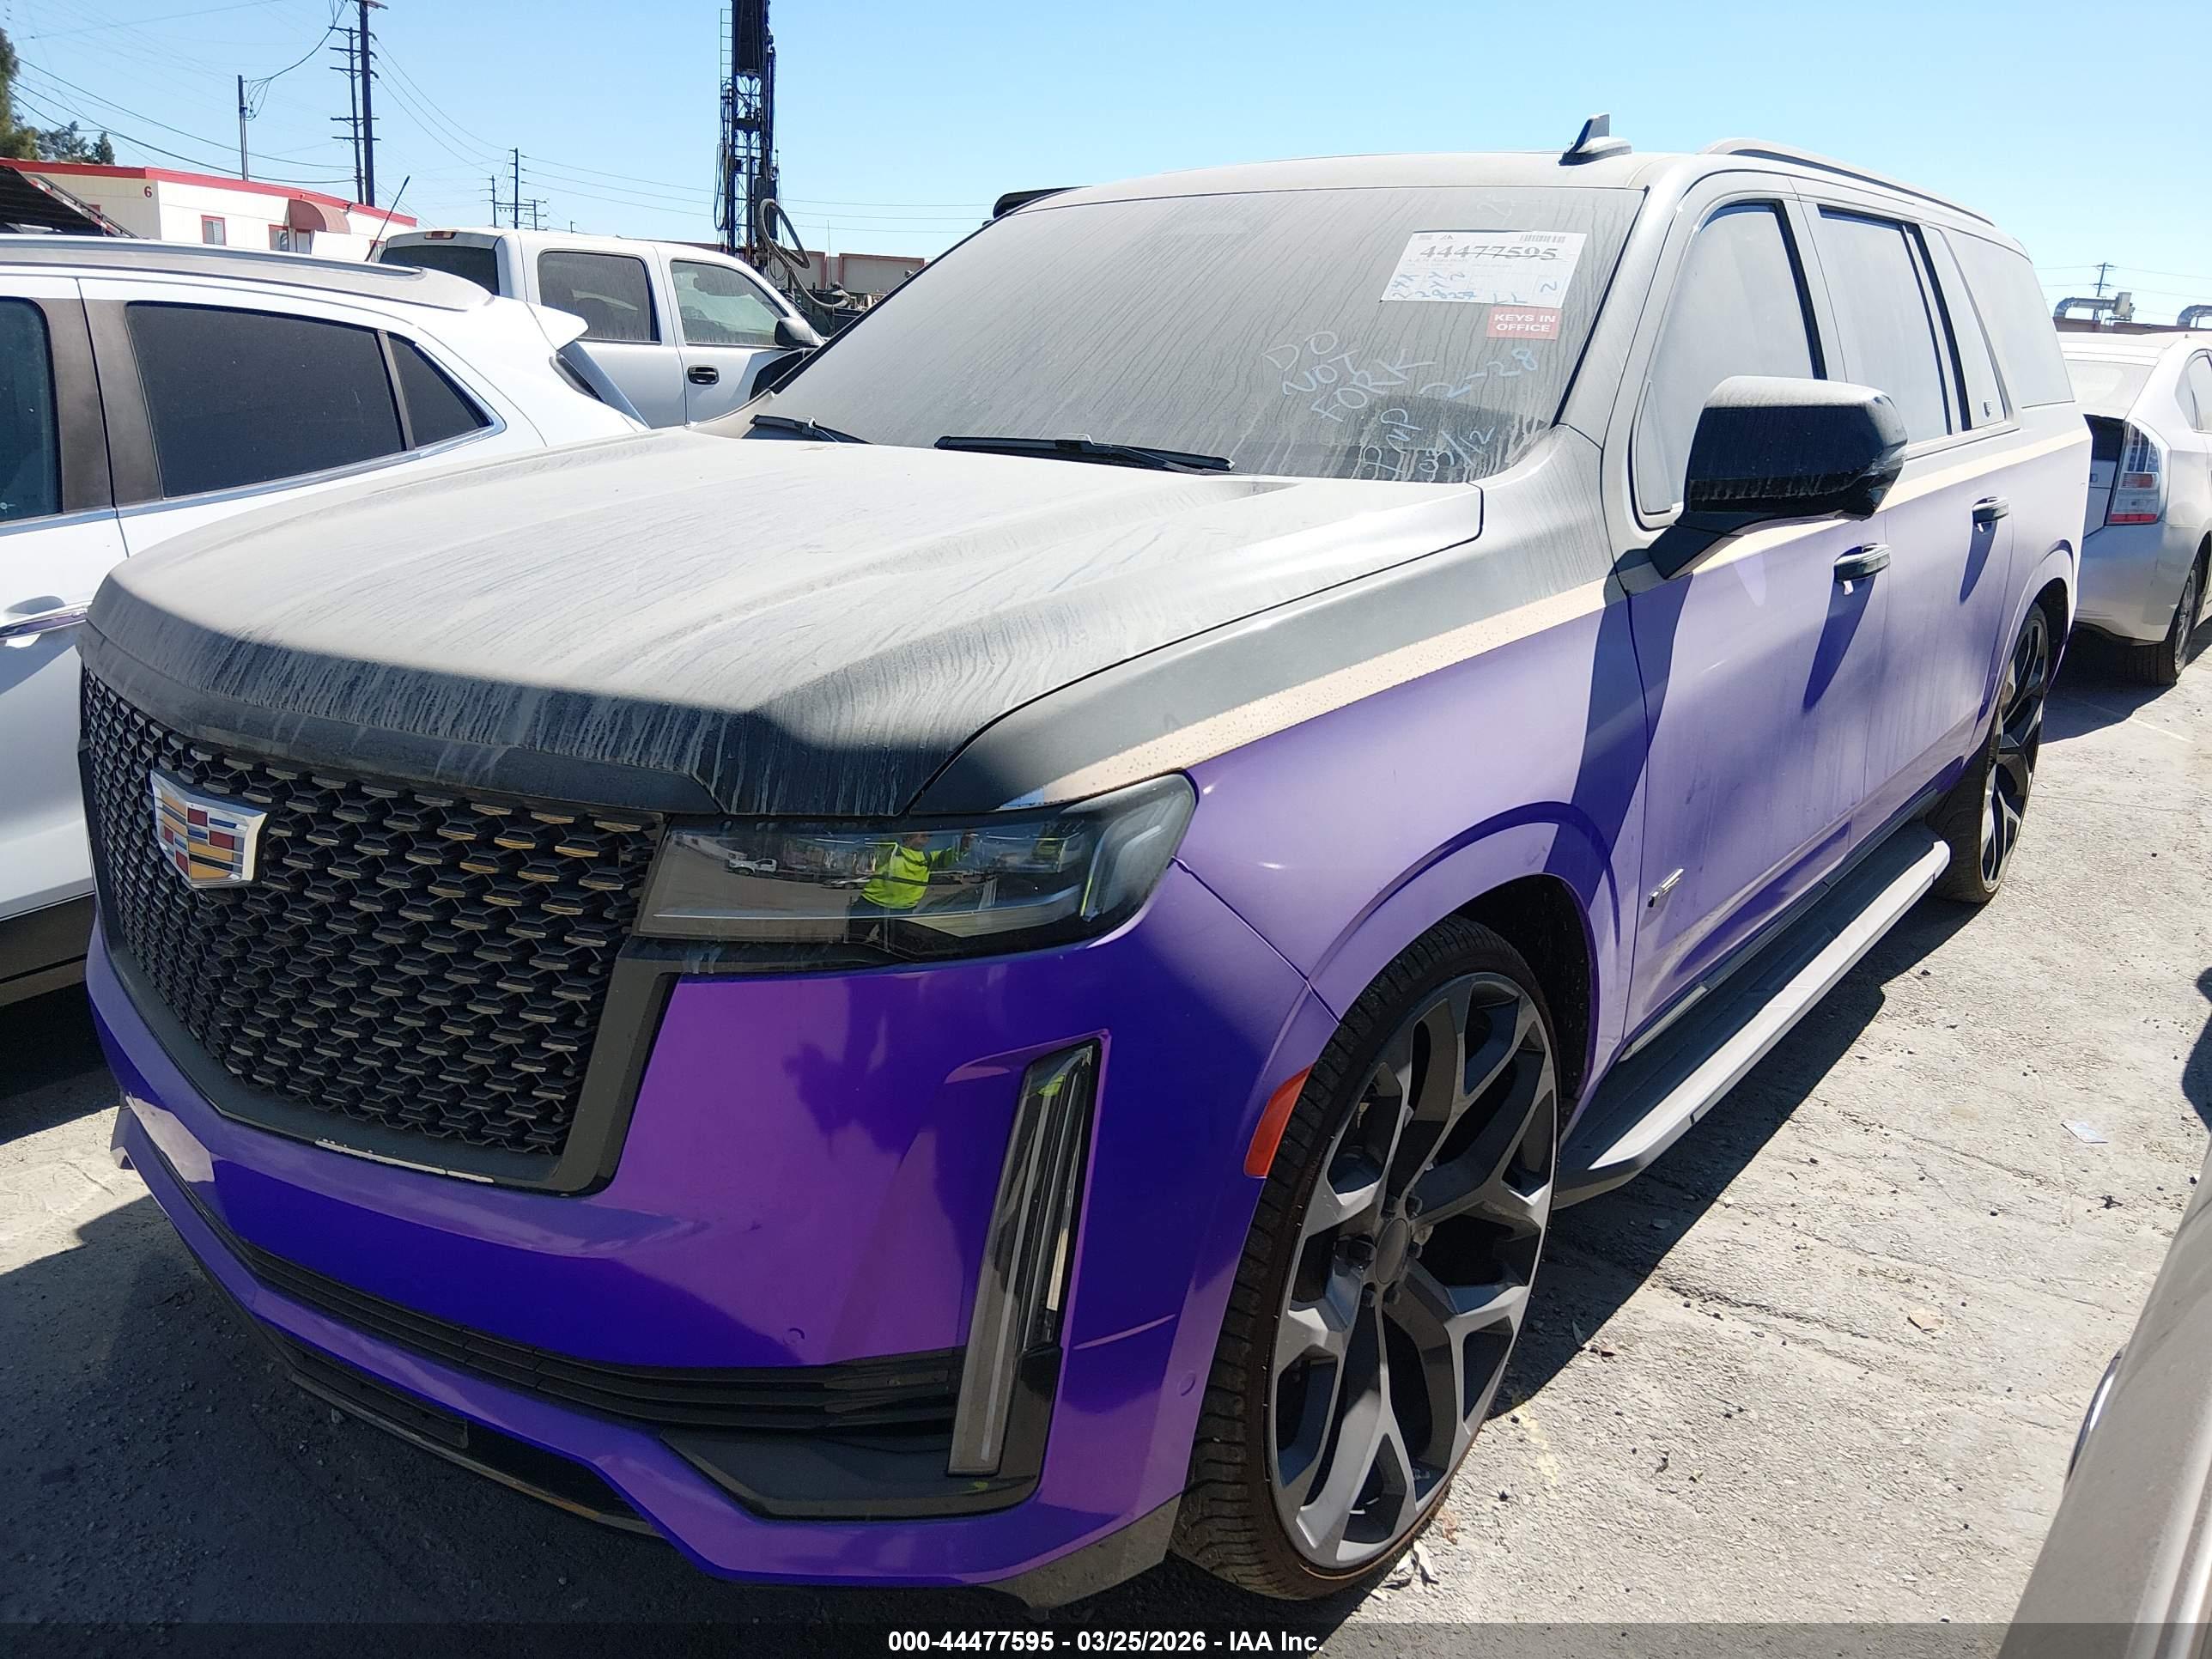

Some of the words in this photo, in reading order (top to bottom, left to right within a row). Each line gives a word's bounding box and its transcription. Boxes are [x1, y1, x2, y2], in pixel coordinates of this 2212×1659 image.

[144, 186, 152, 198] 6
[1420, 245, 1559, 260] 44477595
[1496, 323, 1551, 332] OFFICE
[1261, 331, 1338, 371] DO
[1283, 349, 1360, 396] NOT
[1310, 349, 1437, 422] FORK
